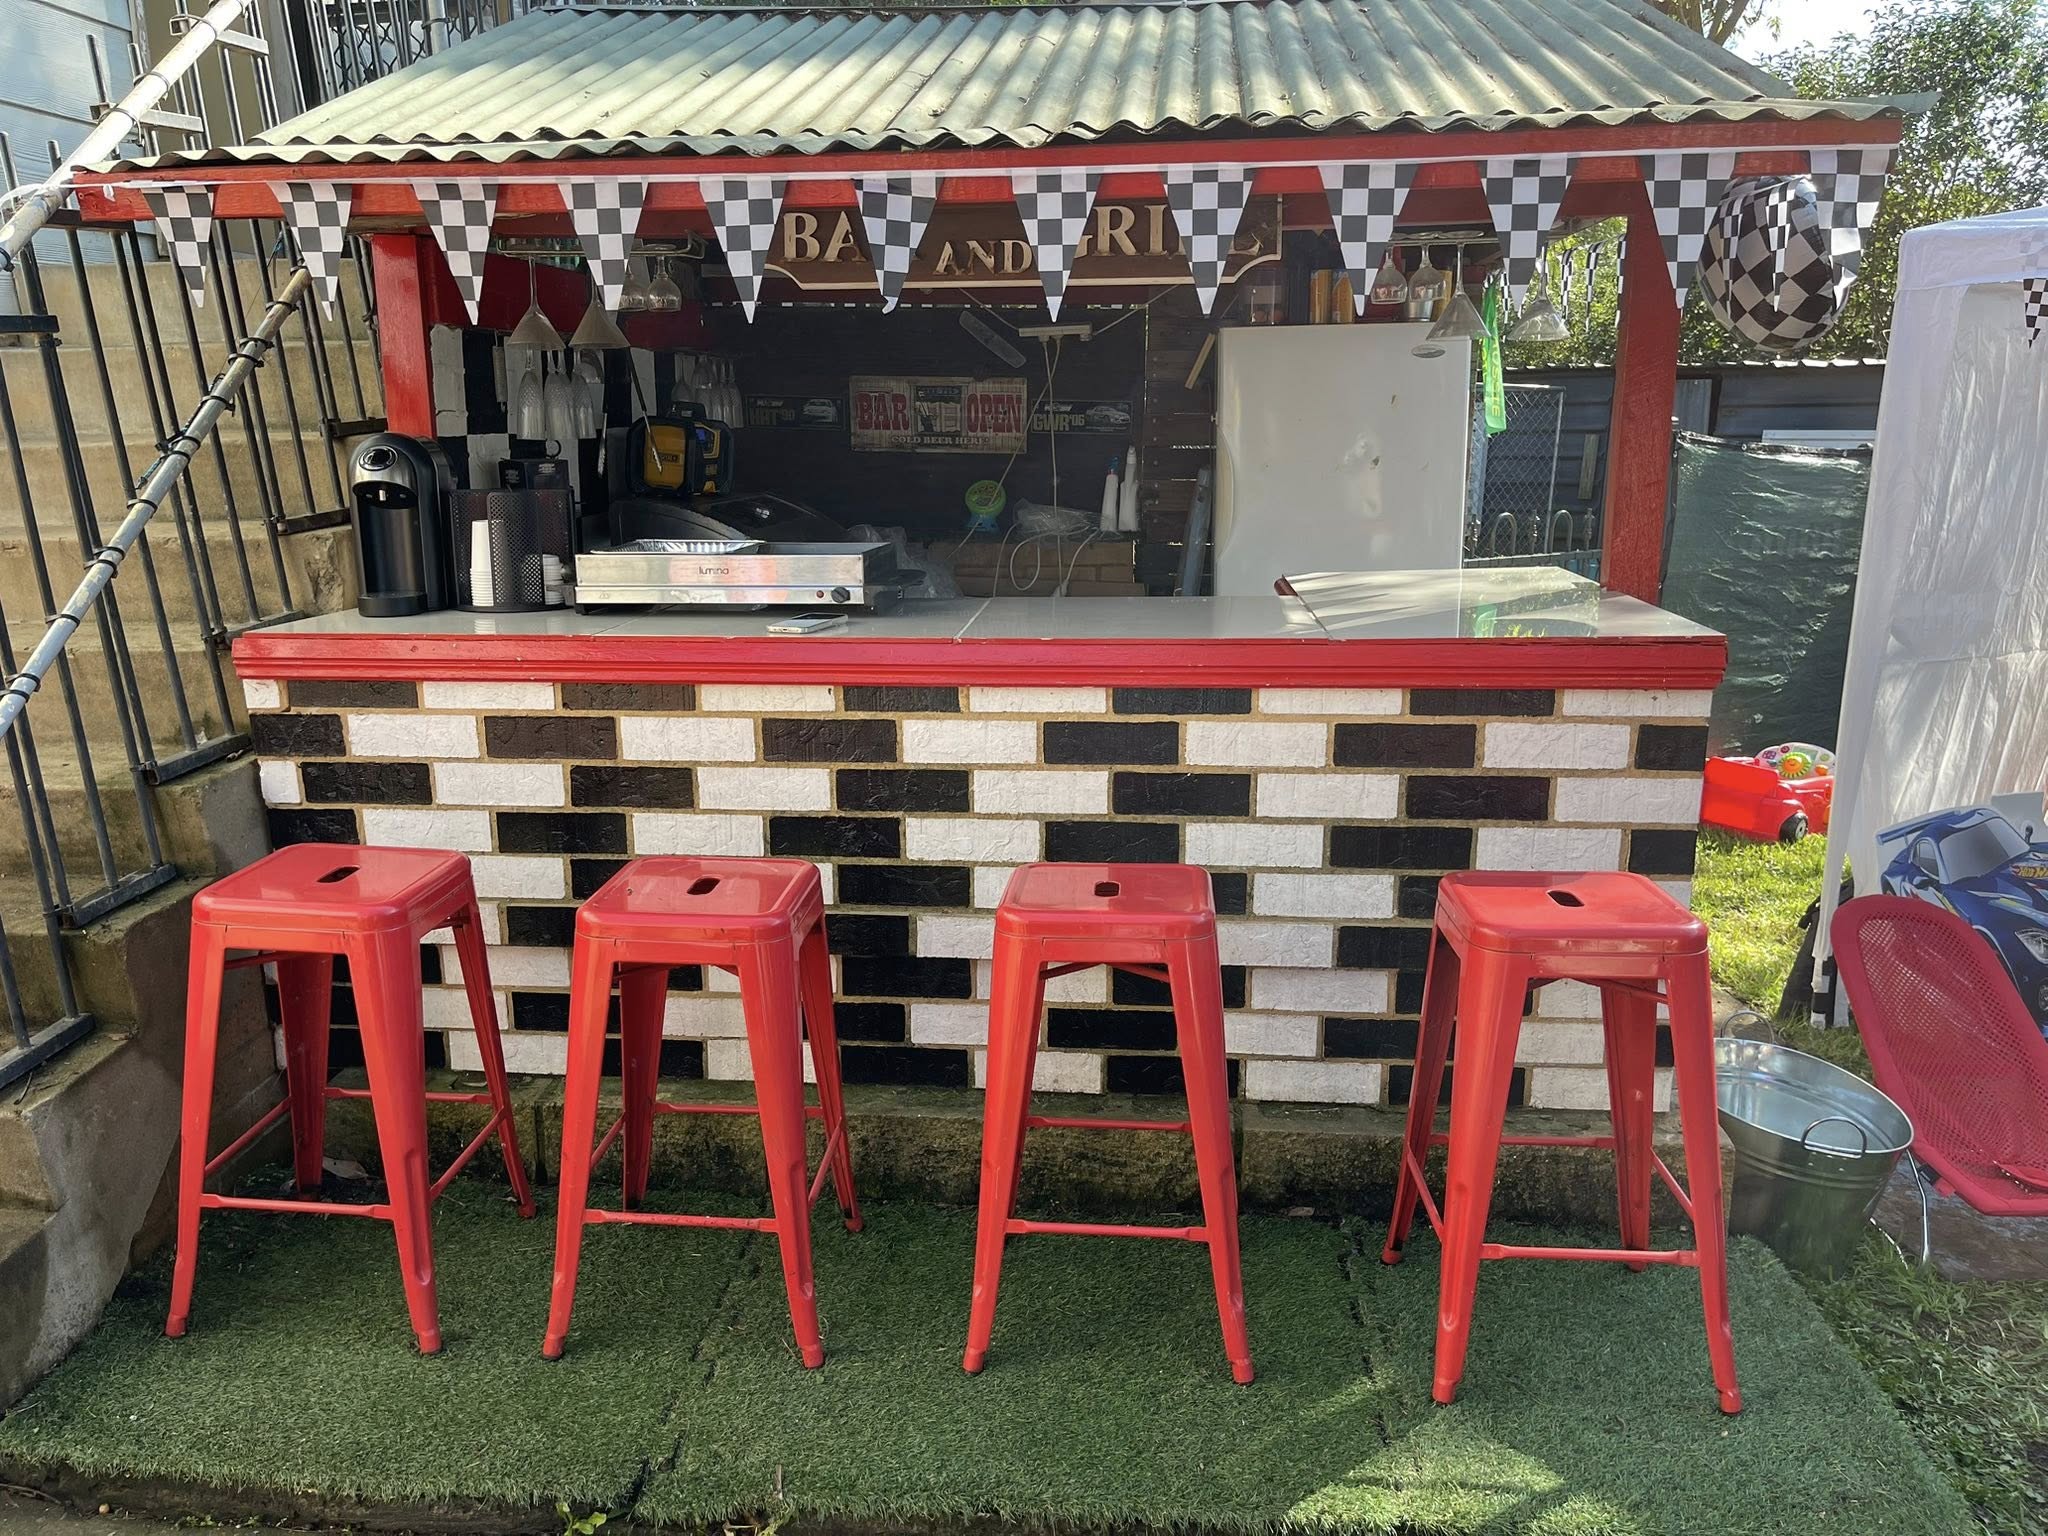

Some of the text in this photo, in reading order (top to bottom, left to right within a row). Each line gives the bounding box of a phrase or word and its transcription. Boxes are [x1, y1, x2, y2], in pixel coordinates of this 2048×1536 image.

[932, 239, 1034, 276] AND
[1074, 204, 1260, 259] RIL
[855, 391, 1024, 433] BAR OPEN
[891, 435, 921, 445] COLD
[923, 436, 953, 445] BEER
[696, 565, 730, 575] lumina
